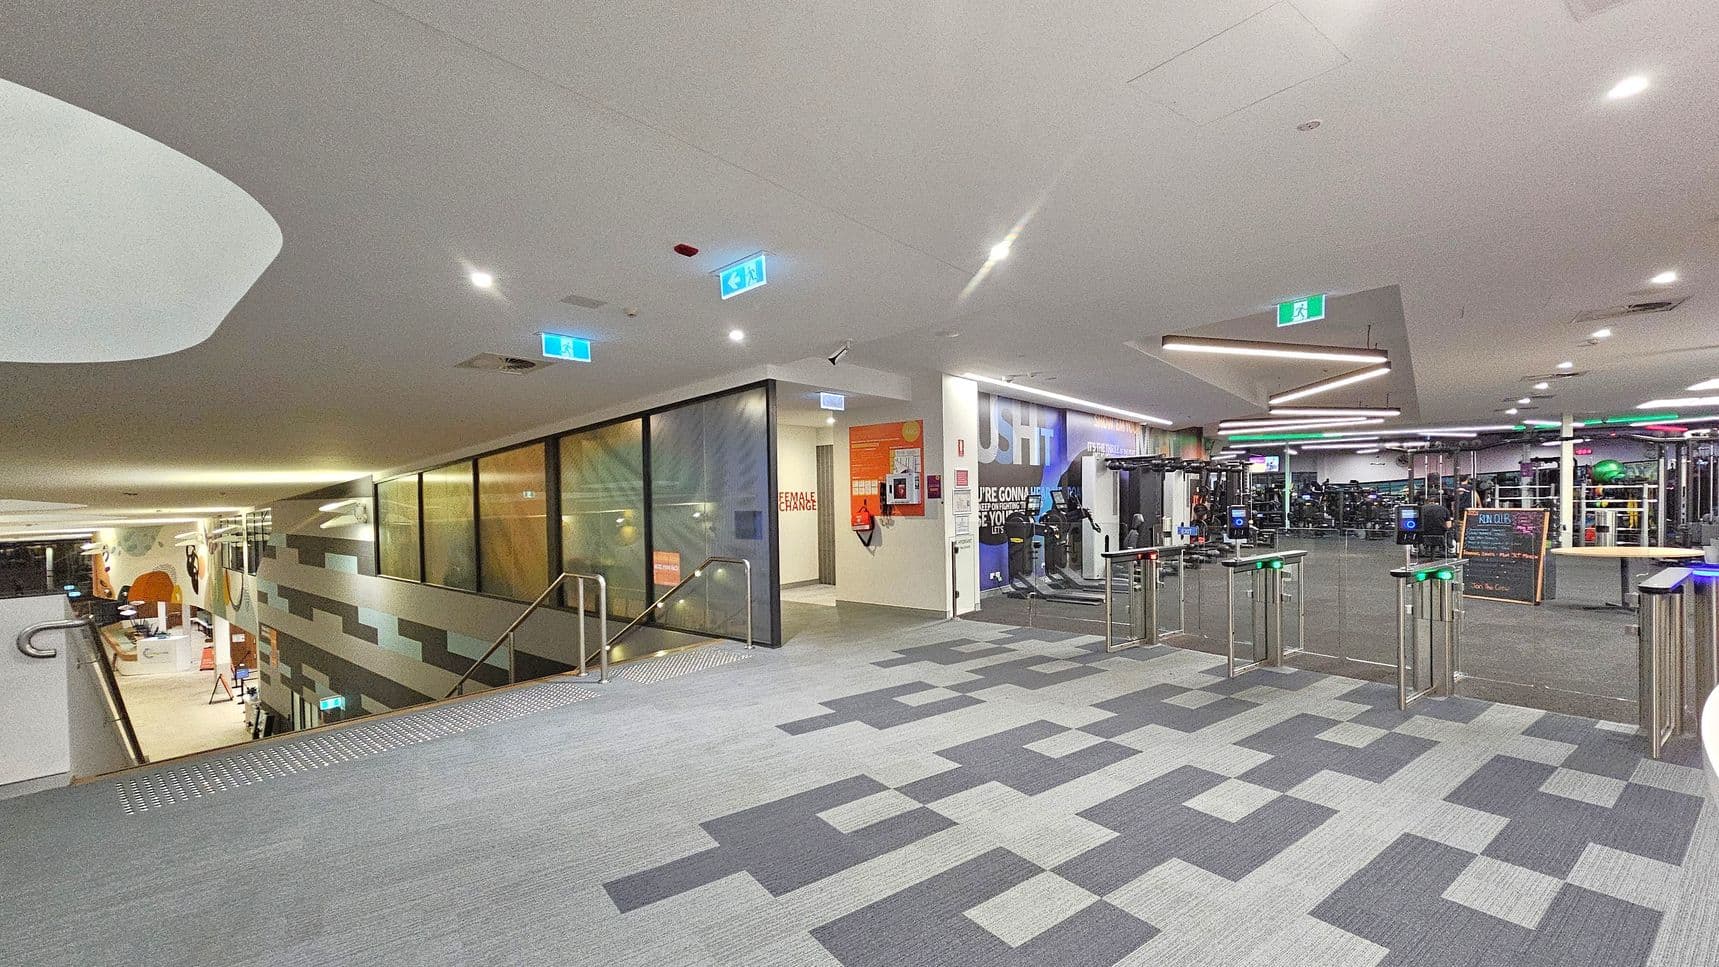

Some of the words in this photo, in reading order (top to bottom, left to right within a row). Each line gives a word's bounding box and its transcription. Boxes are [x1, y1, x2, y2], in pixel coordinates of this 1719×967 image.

[779, 491, 815, 501] FEMALE
[999, 486, 1029, 502] GONNA
[779, 500, 817, 511] CHANGE
[992, 502, 999, 511] ON
[999, 501, 1020, 511] FIGHTING
[1478, 513, 1493, 524] RUN
[1495, 513, 1512, 524] CLUB
[991, 525, 1004, 535] LET'S
